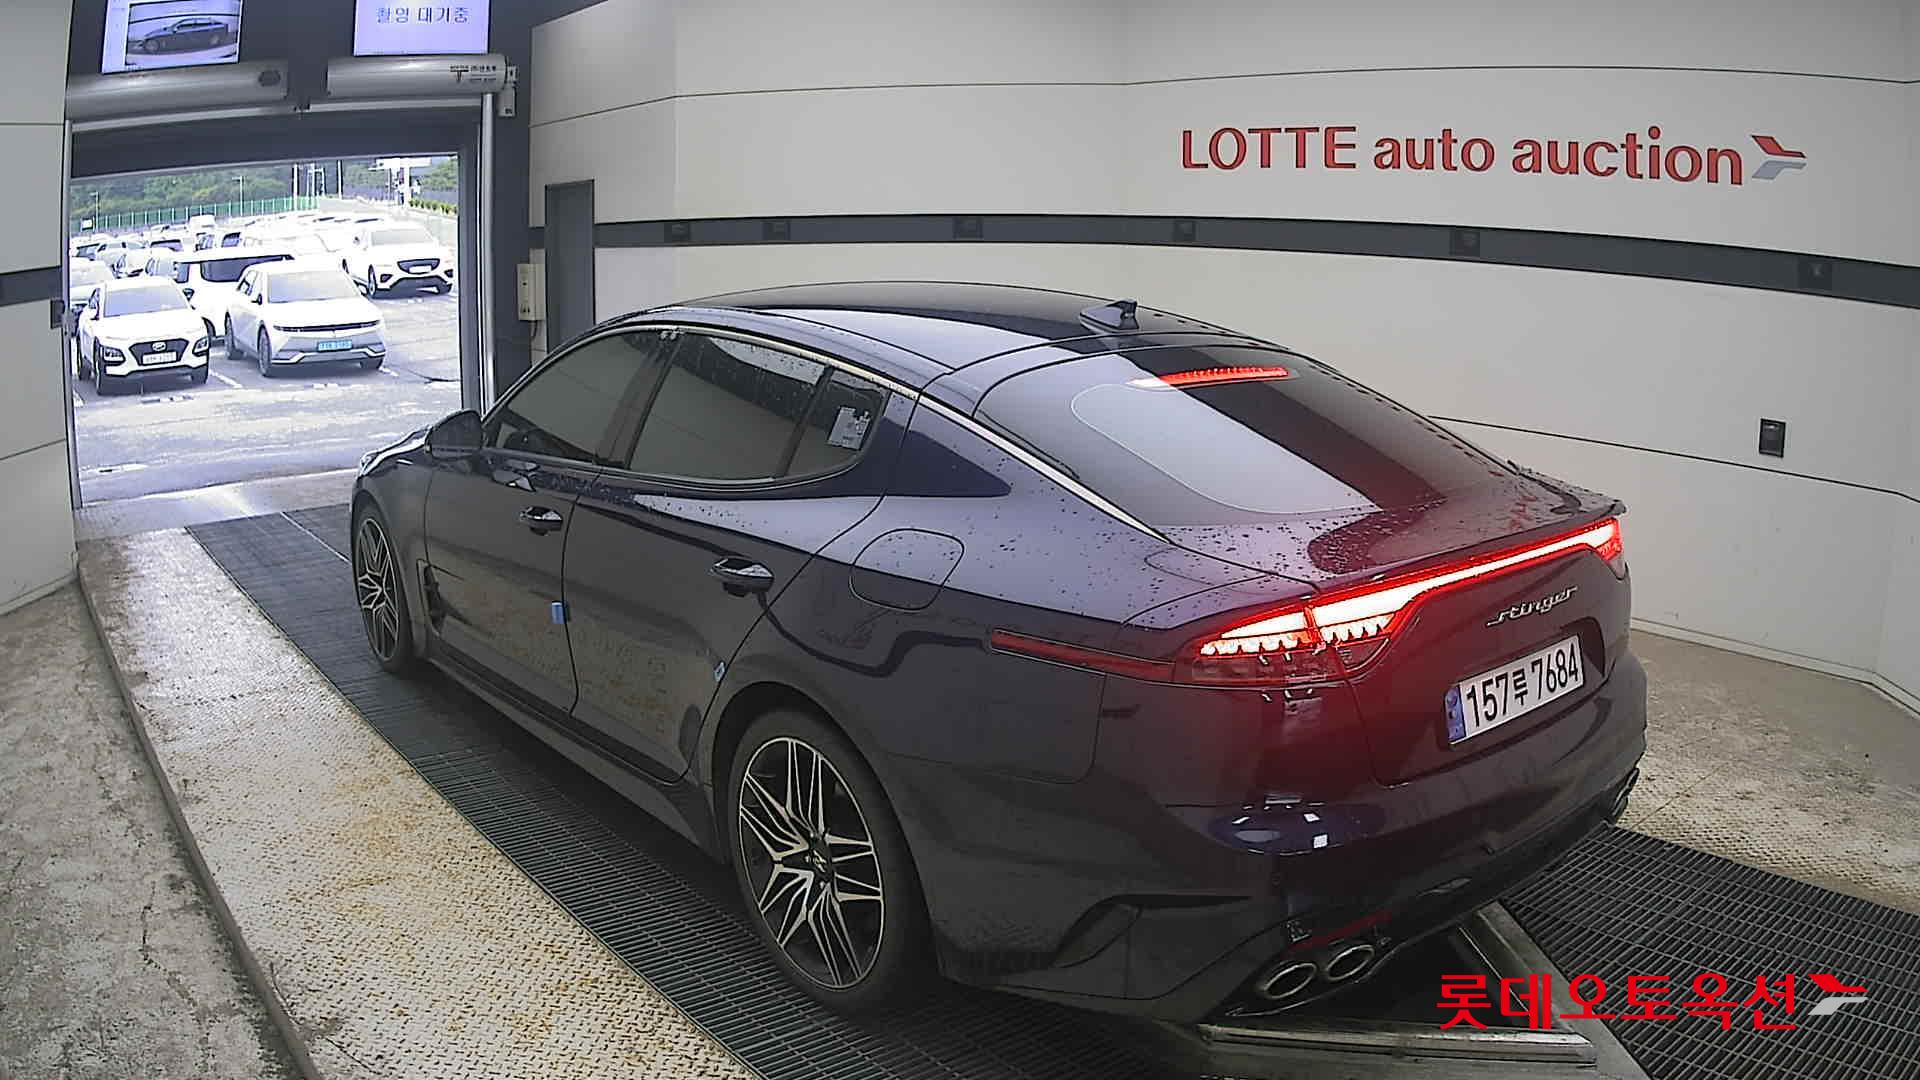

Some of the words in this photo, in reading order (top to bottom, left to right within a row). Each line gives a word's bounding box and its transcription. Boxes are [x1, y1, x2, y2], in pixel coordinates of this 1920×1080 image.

[417, 7, 469, 24] 대기중
[1182, 126, 1357, 169] LOTTE
[1373, 128, 1496, 172] auto
[1511, 125, 1743, 185] auction
[1466, 668, 1528, 728] 157루
[1531, 643, 1579, 700] 7684
